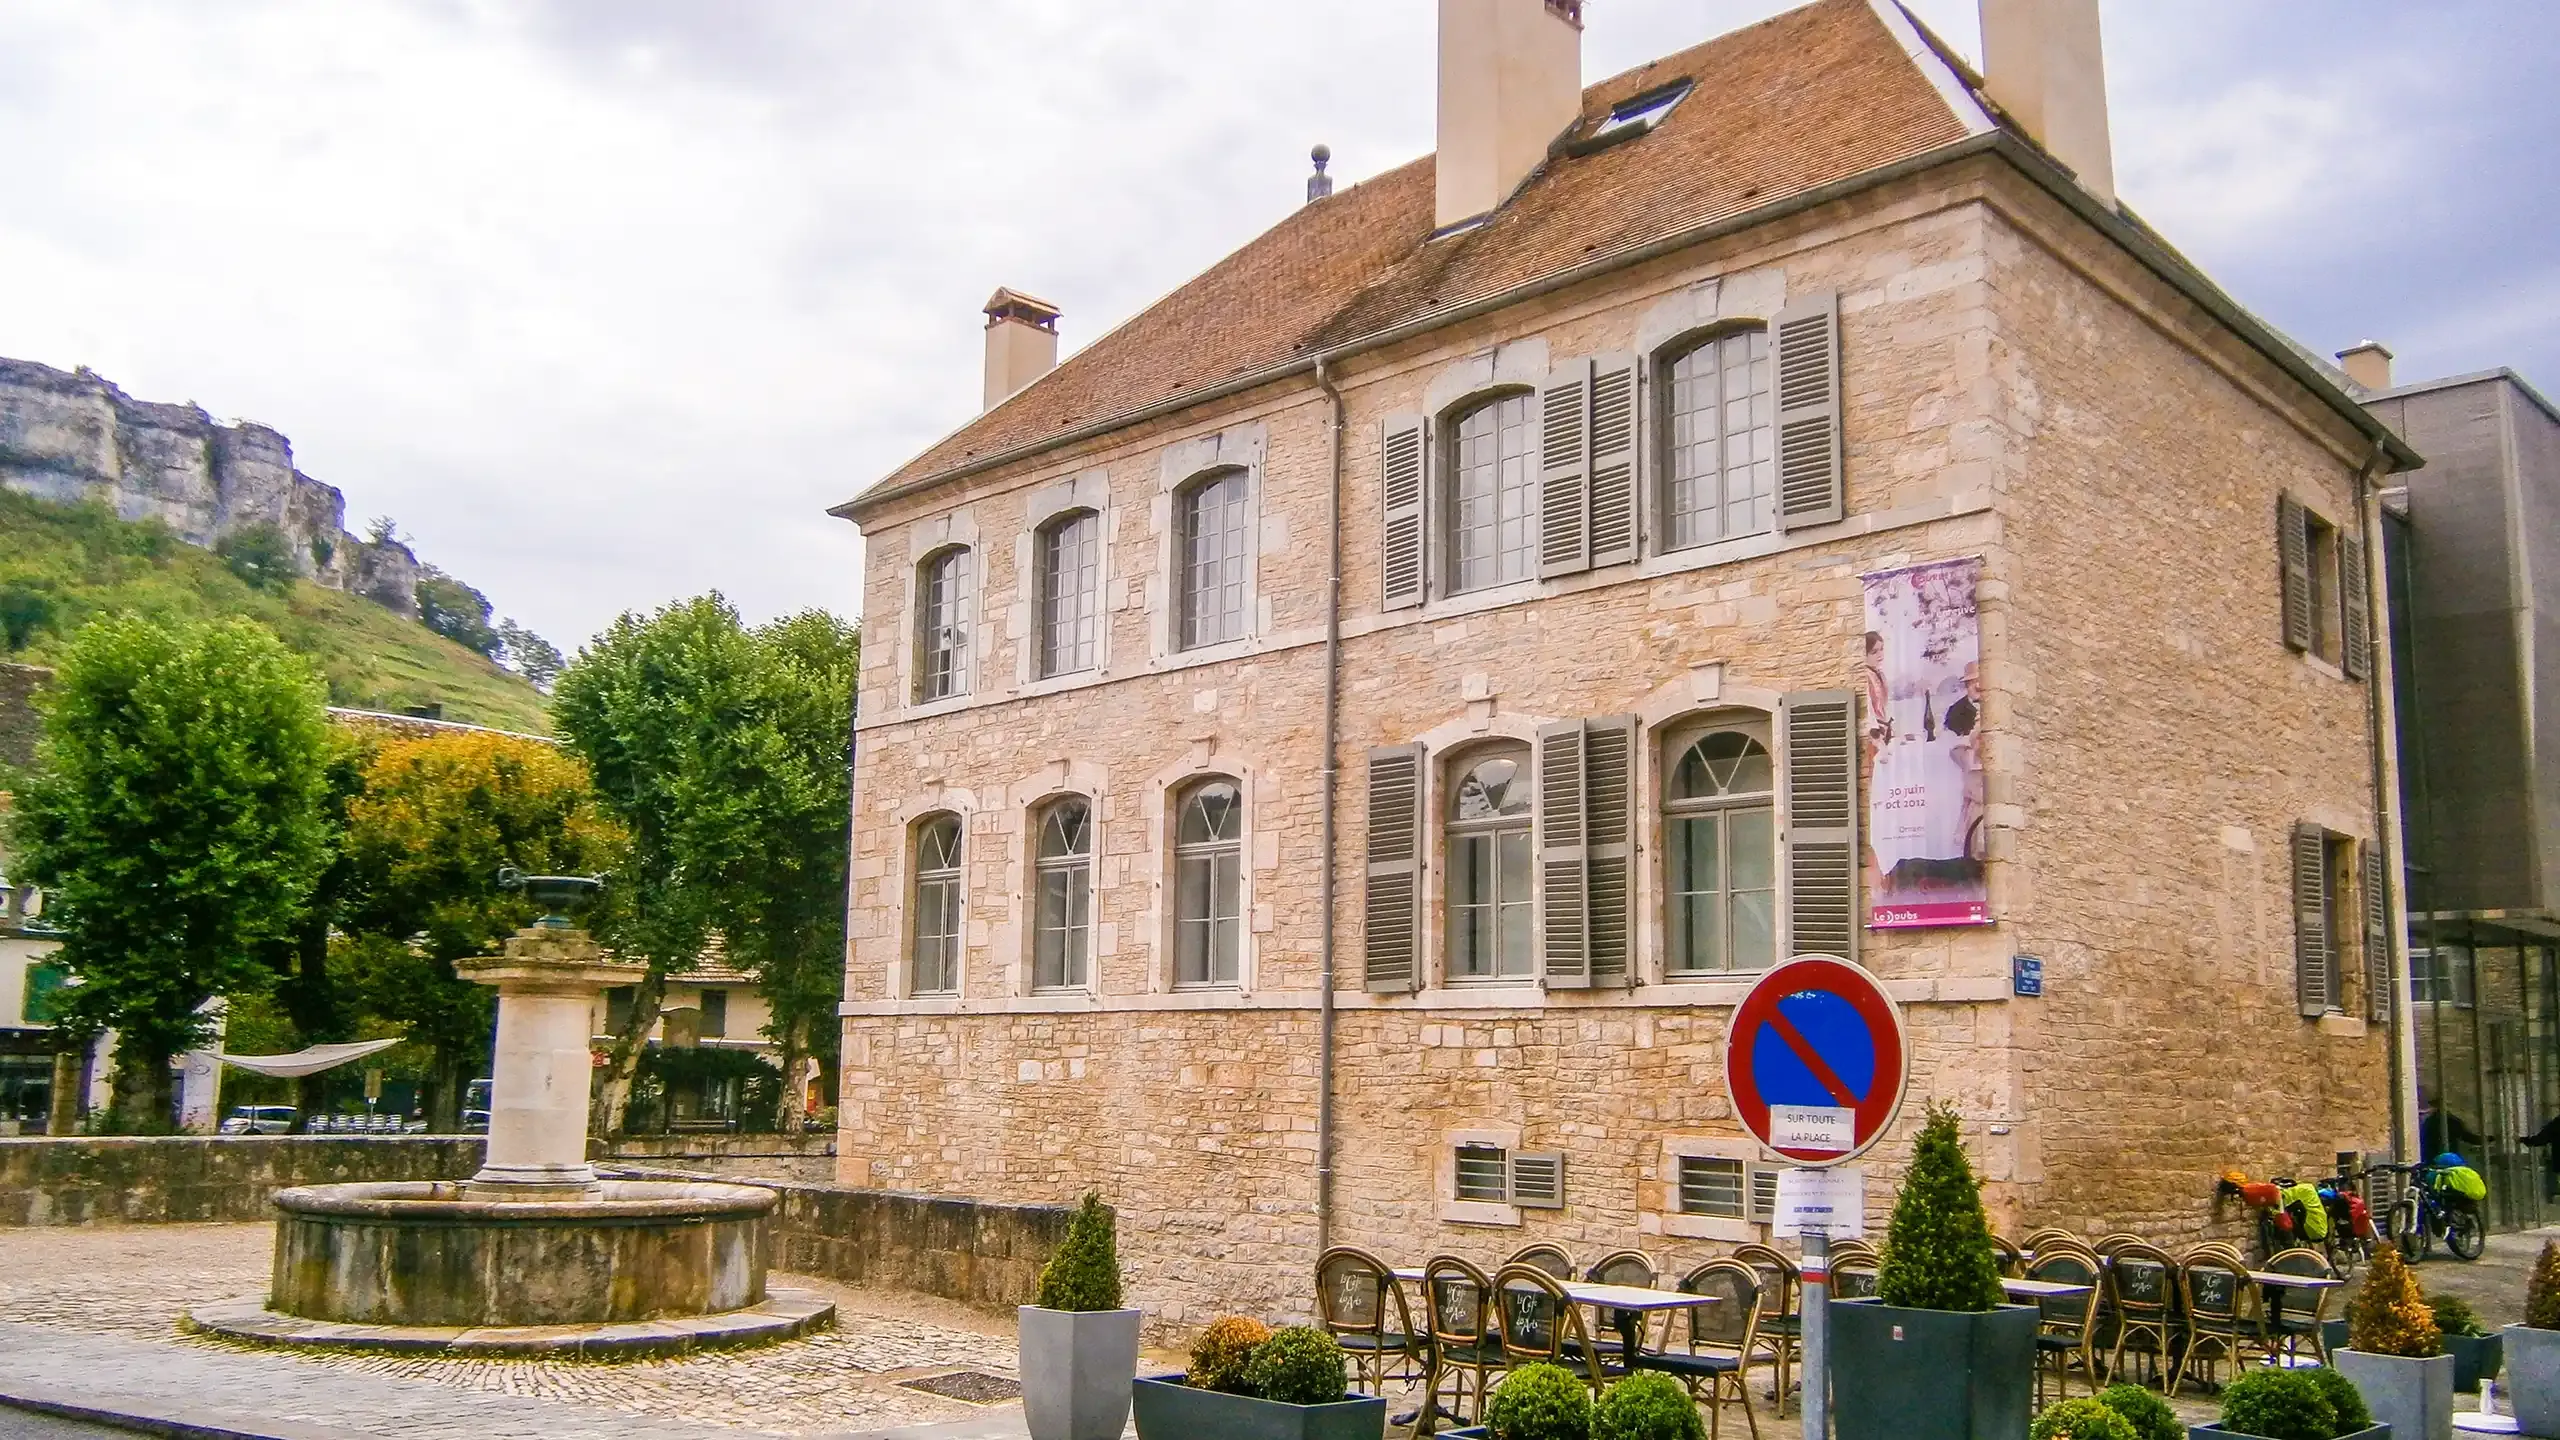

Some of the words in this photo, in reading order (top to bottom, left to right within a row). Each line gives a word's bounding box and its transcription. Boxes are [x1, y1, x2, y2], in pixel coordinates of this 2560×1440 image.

[1889, 788, 1901, 798] 30
[1904, 784, 1925, 798] juin
[1885, 800, 1901, 810] oct
[1904, 799, 1926, 808] 2012
[1874, 912, 1885, 921] Le
[1787, 1113, 1805, 1123] SUR
[1806, 1114, 1836, 1124] TOUTE
[1791, 1132, 1801, 1141] LA
[1803, 1132, 1831, 1142] PLACE
